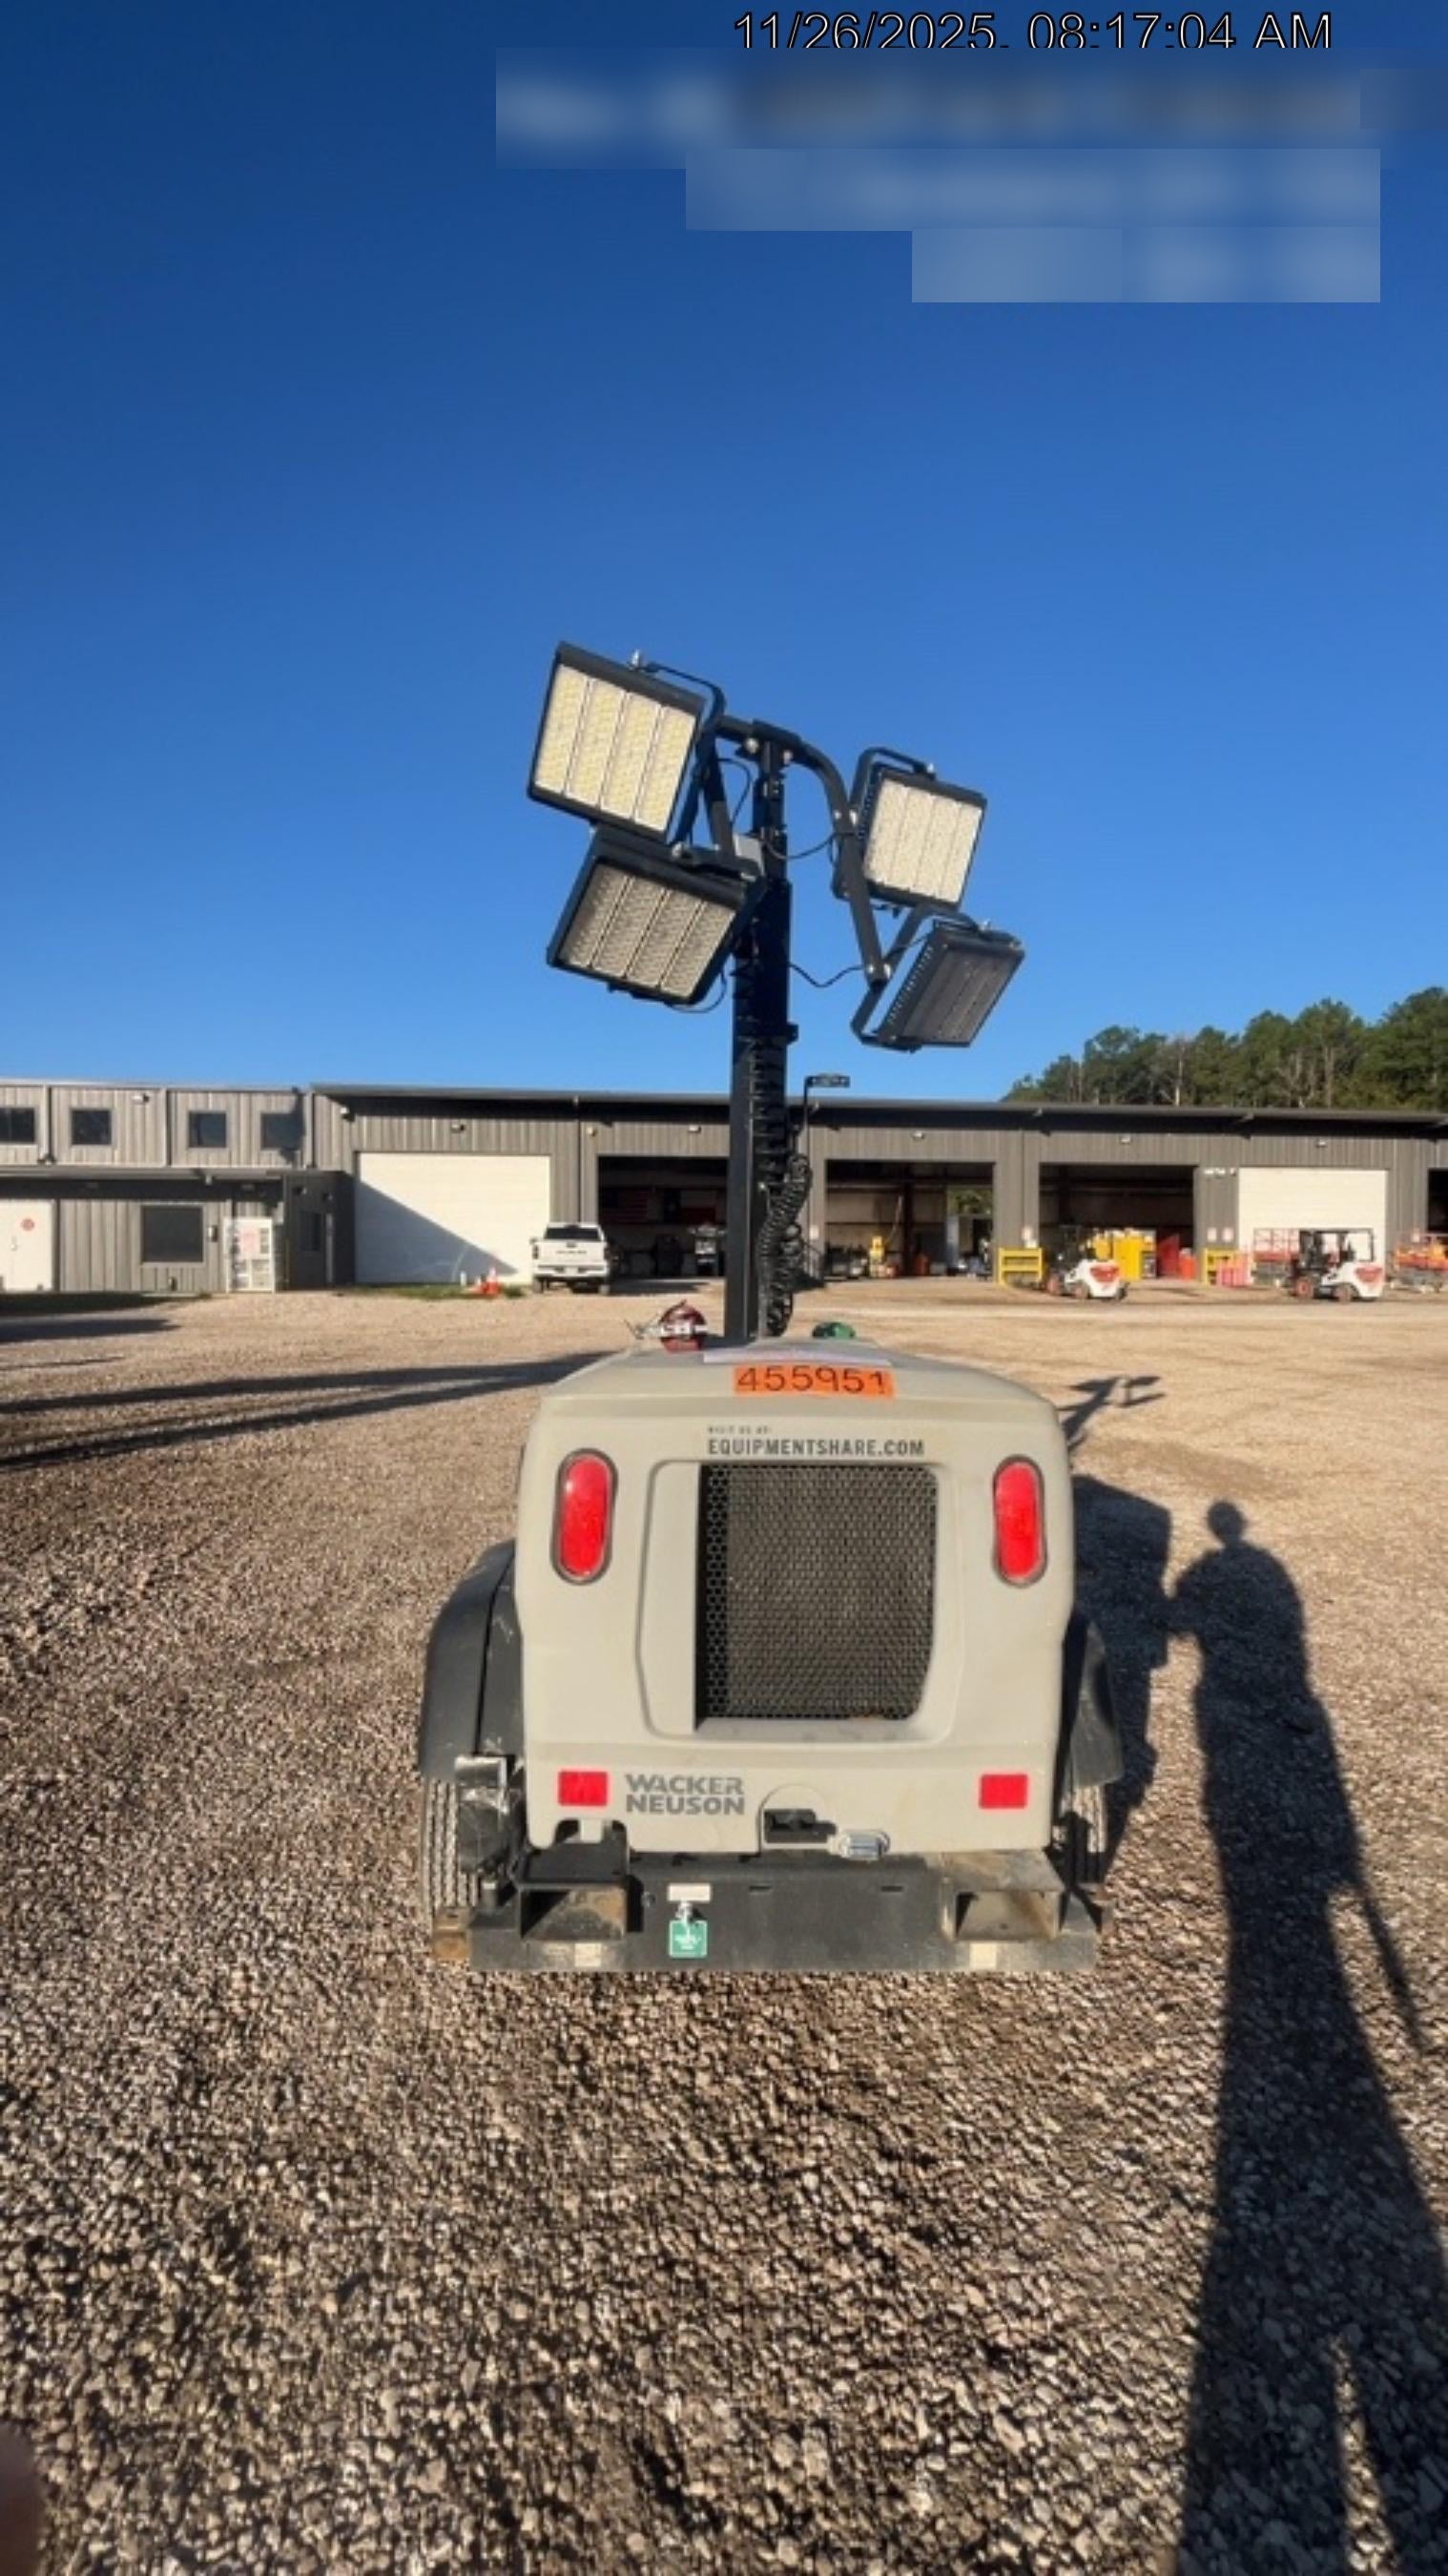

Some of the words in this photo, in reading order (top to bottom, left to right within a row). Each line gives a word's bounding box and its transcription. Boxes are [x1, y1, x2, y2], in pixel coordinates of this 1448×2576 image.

[737, 1365, 885, 1395] 455951
[708, 1439, 925, 1456] EQUIPMENTSHARE.COM
[625, 1773, 745, 1795] WACKER
[626, 1794, 745, 1815] NEUSON
